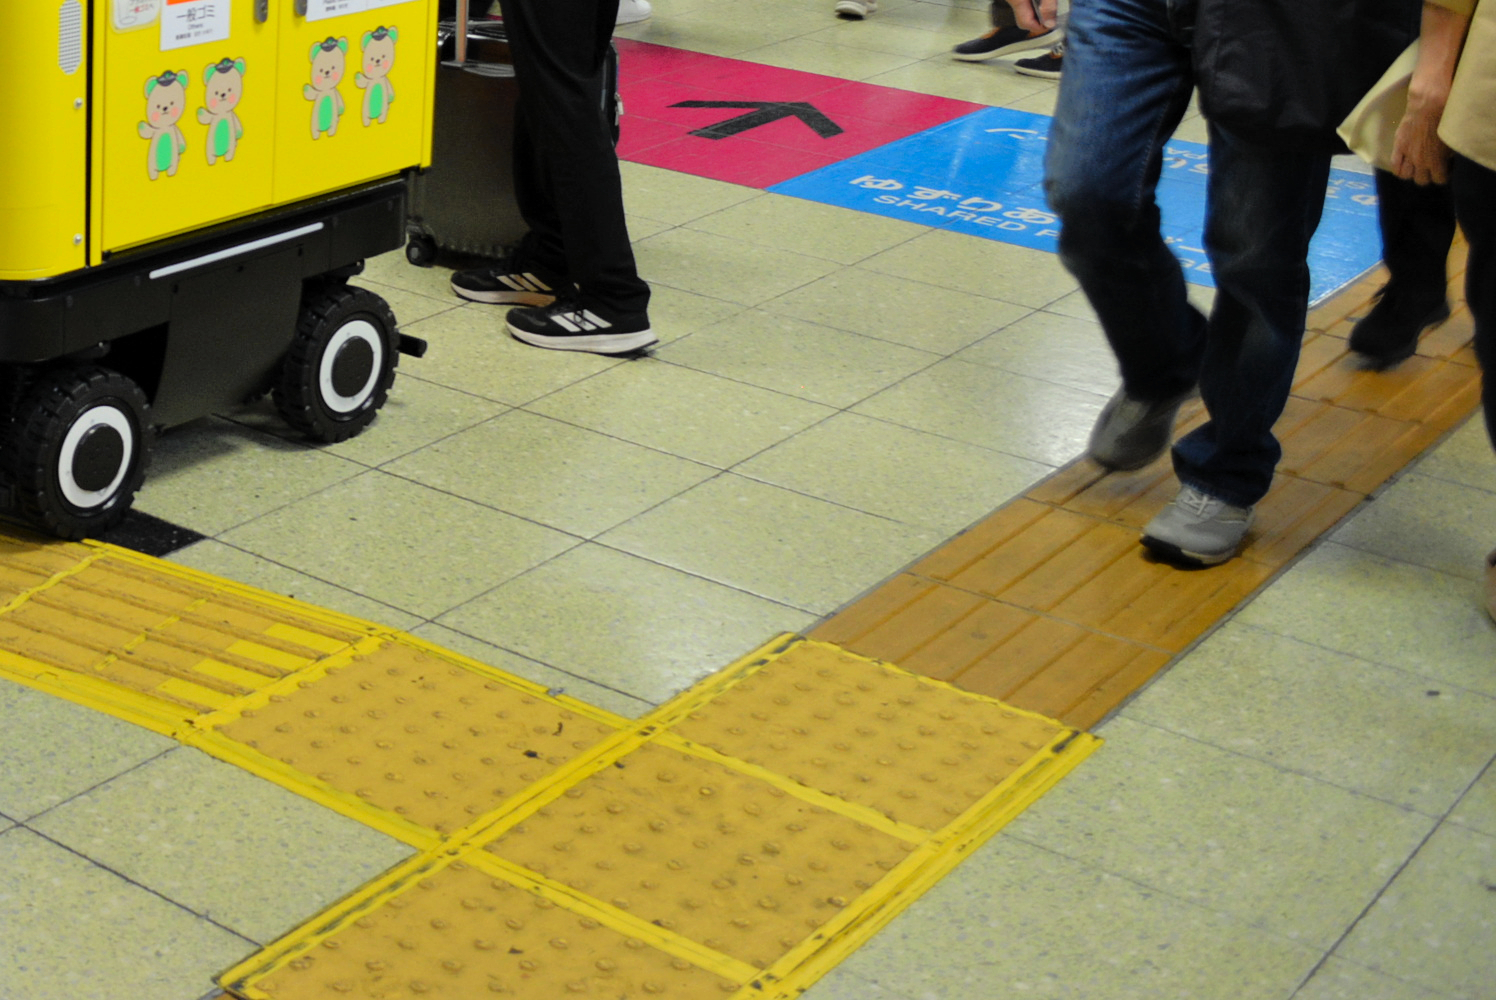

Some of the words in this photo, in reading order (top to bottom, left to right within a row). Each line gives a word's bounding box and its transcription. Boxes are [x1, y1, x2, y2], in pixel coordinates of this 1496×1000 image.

[176, 4, 216, 22] 一般ゴミ
[848, 174, 1060, 225] ゆずりあ
[873, 195, 1028, 231] SHARED
